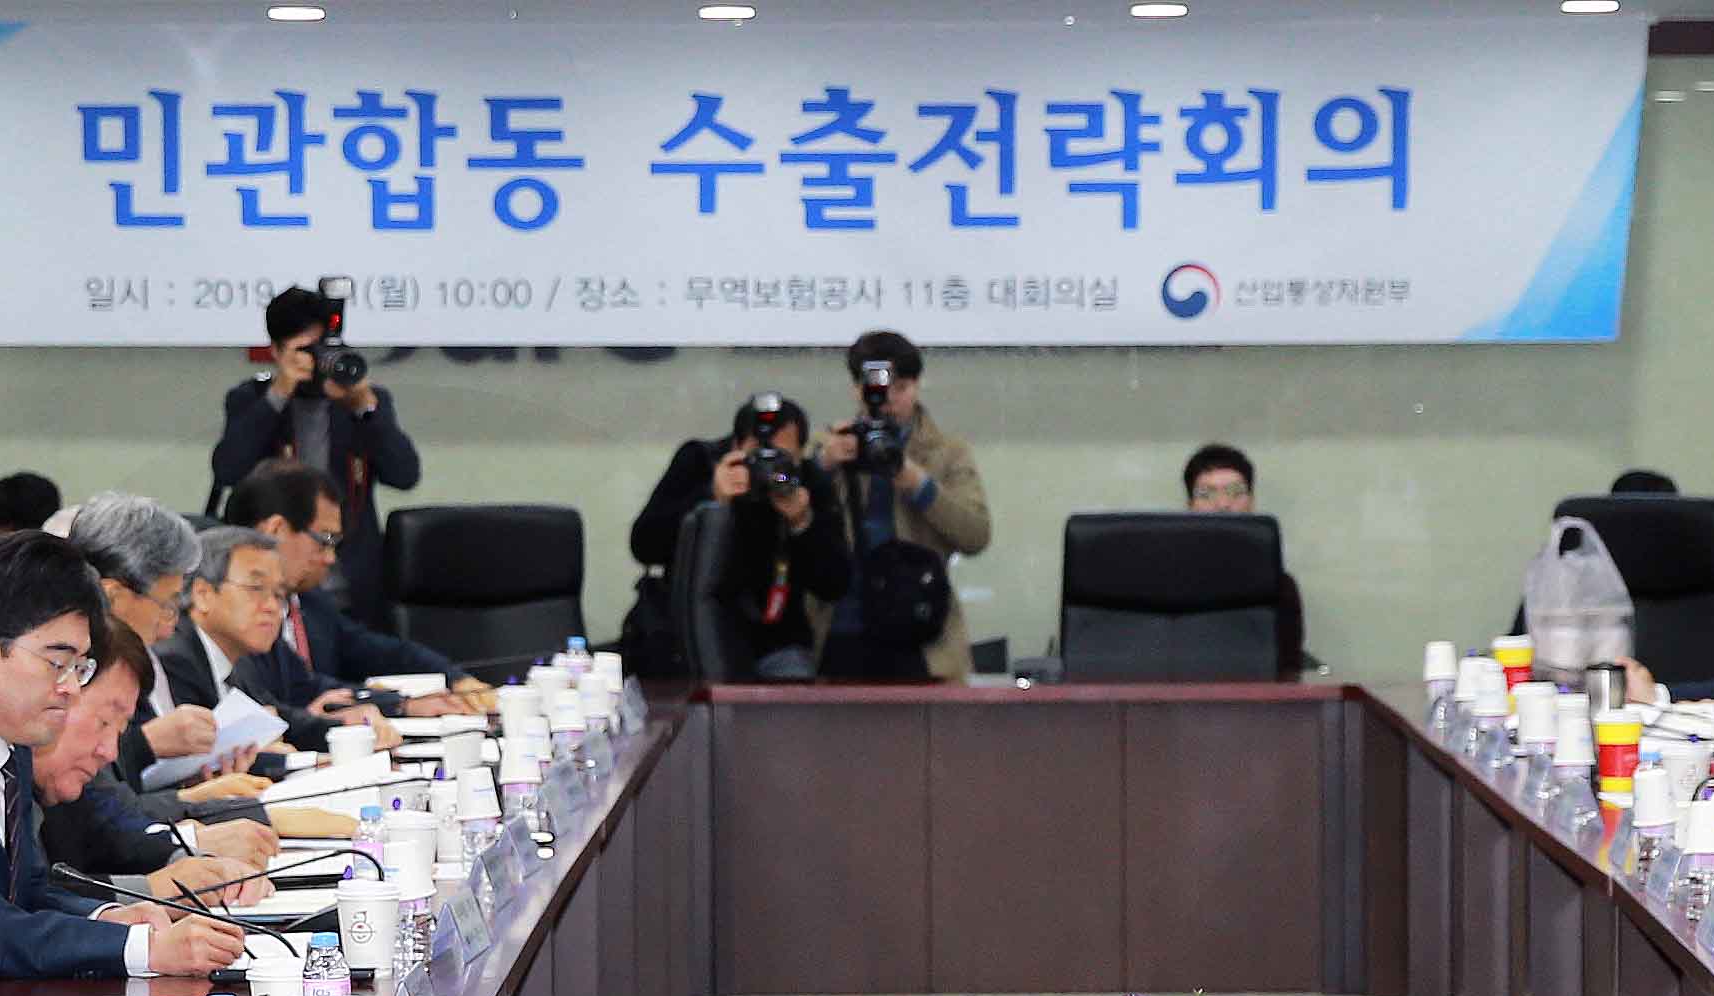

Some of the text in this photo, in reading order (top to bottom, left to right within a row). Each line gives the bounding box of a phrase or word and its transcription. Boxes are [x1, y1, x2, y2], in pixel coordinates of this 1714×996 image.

[77, 86, 1413, 232] 민관합동 수출전략회의
[86, 276, 150, 311] 일시
[438, 278, 534, 308] 10:00
[576, 276, 640, 312] 장소
[687, 275, 882, 311] 무역보험공사
[903, 275, 971, 311] 11층
[988, 275, 1119, 311] 대회의실
